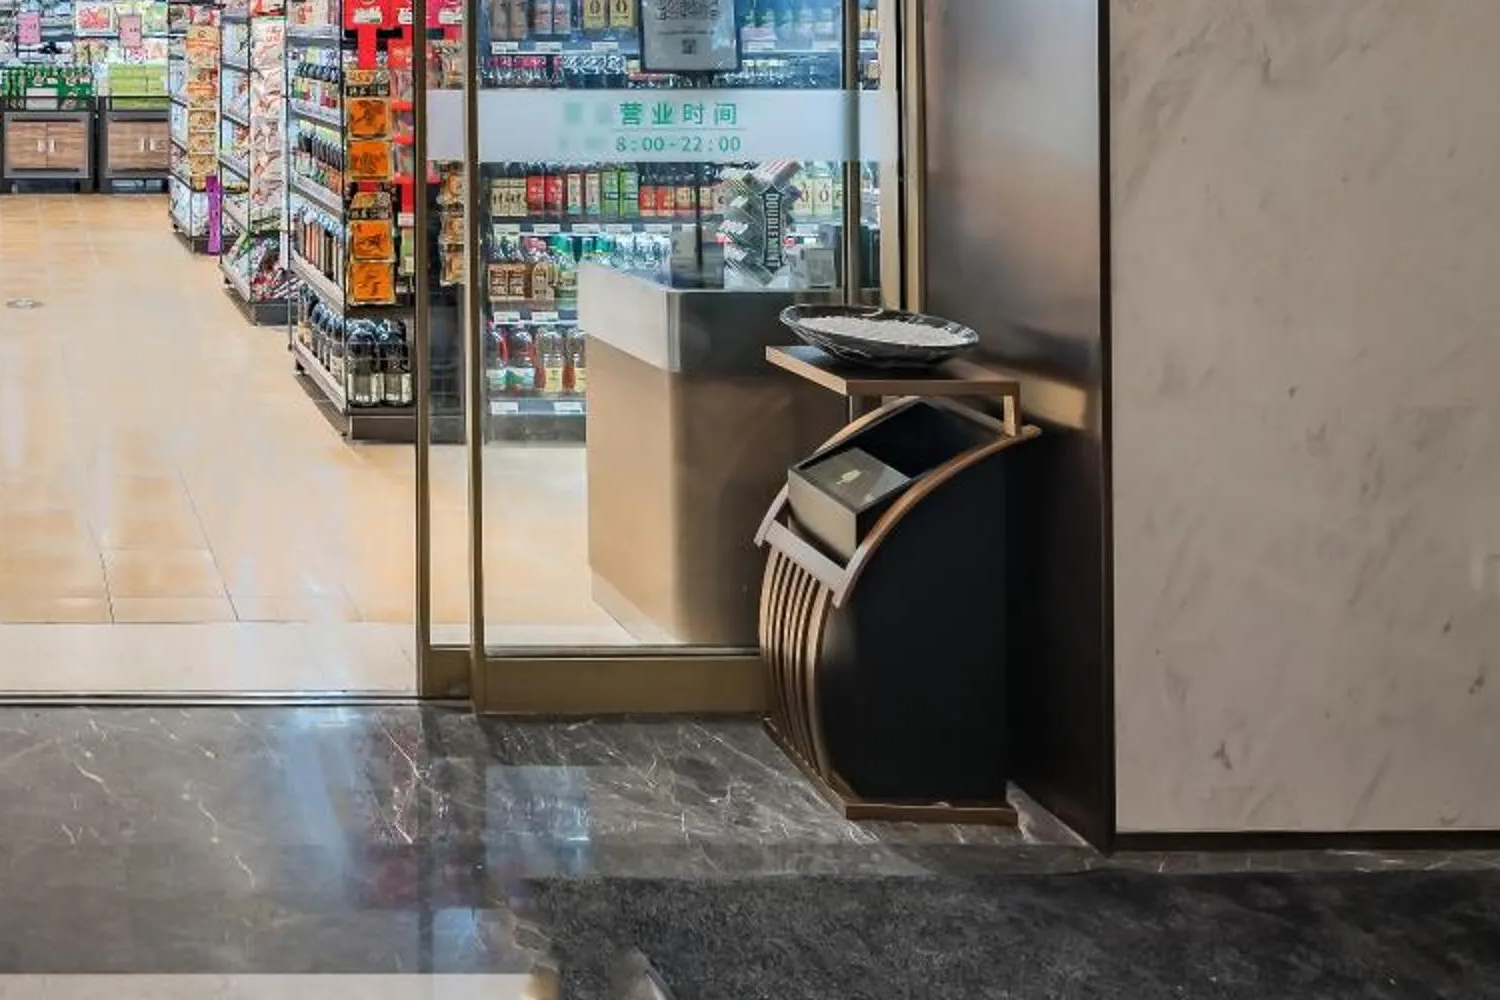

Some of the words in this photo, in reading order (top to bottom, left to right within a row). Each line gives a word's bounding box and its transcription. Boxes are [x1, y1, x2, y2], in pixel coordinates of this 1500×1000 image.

[619, 102, 737, 126] 营业时间
[615, 136, 741, 153] 8:00-22:00
